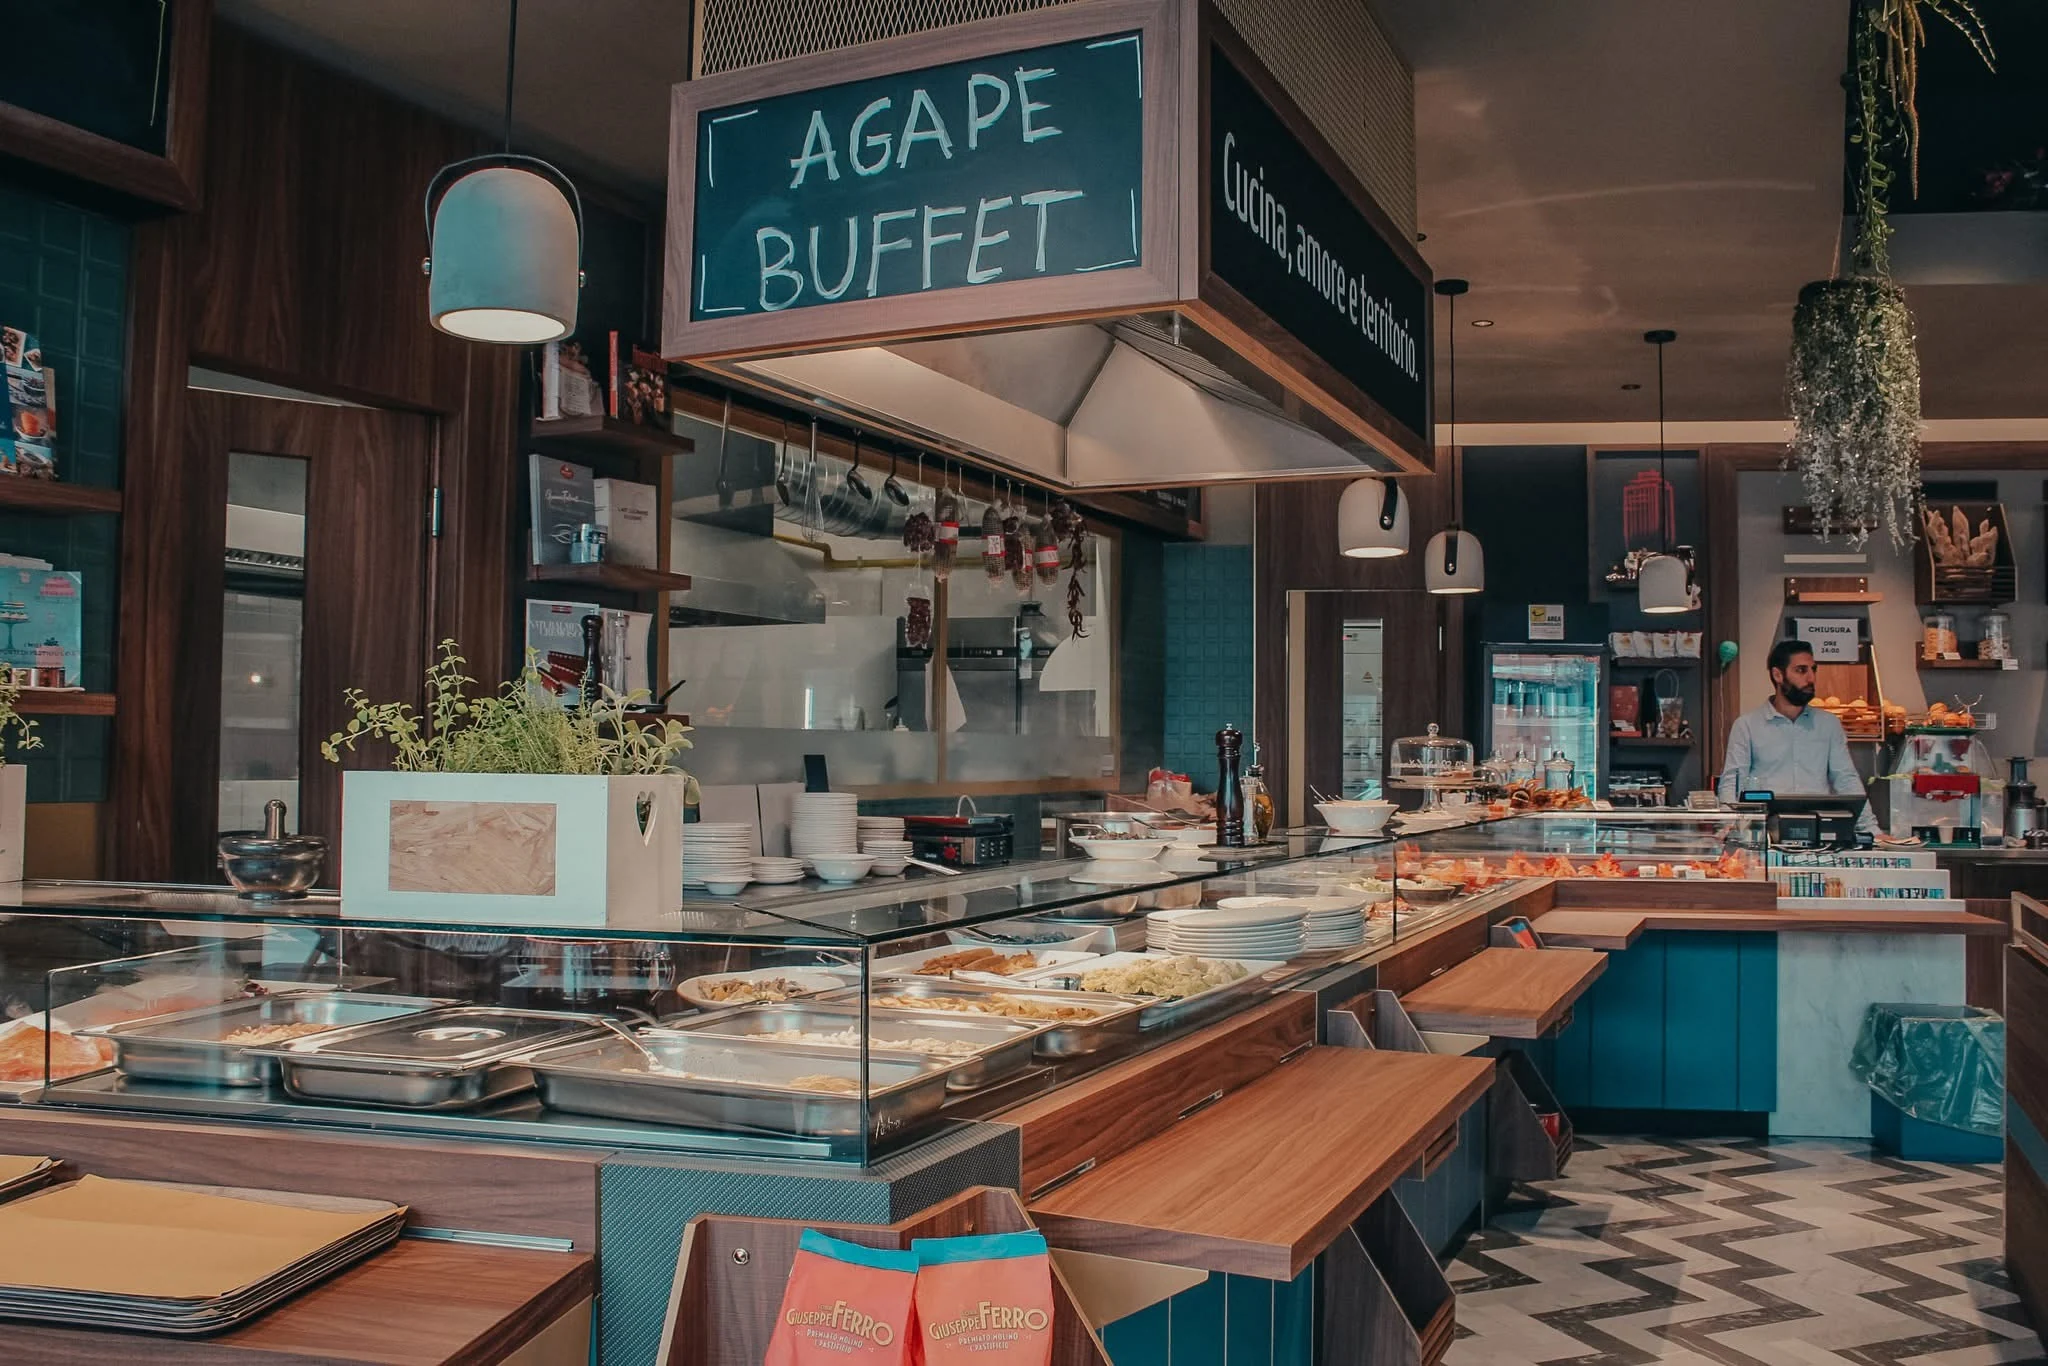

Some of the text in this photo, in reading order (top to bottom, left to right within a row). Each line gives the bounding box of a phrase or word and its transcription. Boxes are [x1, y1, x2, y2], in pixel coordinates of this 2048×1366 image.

[790, 67, 1063, 189] AGAPE
[757, 190, 1084, 312] BUFFET
[1224, 132, 1419, 382] Cucina, amore e territorio.
[831, 1300, 894, 1346] FERRO
[978, 1301, 1049, 1331] FERRO
[992, 1331, 1019, 1341] MOLINO
[839, 1335, 863, 1348] MOLINO
